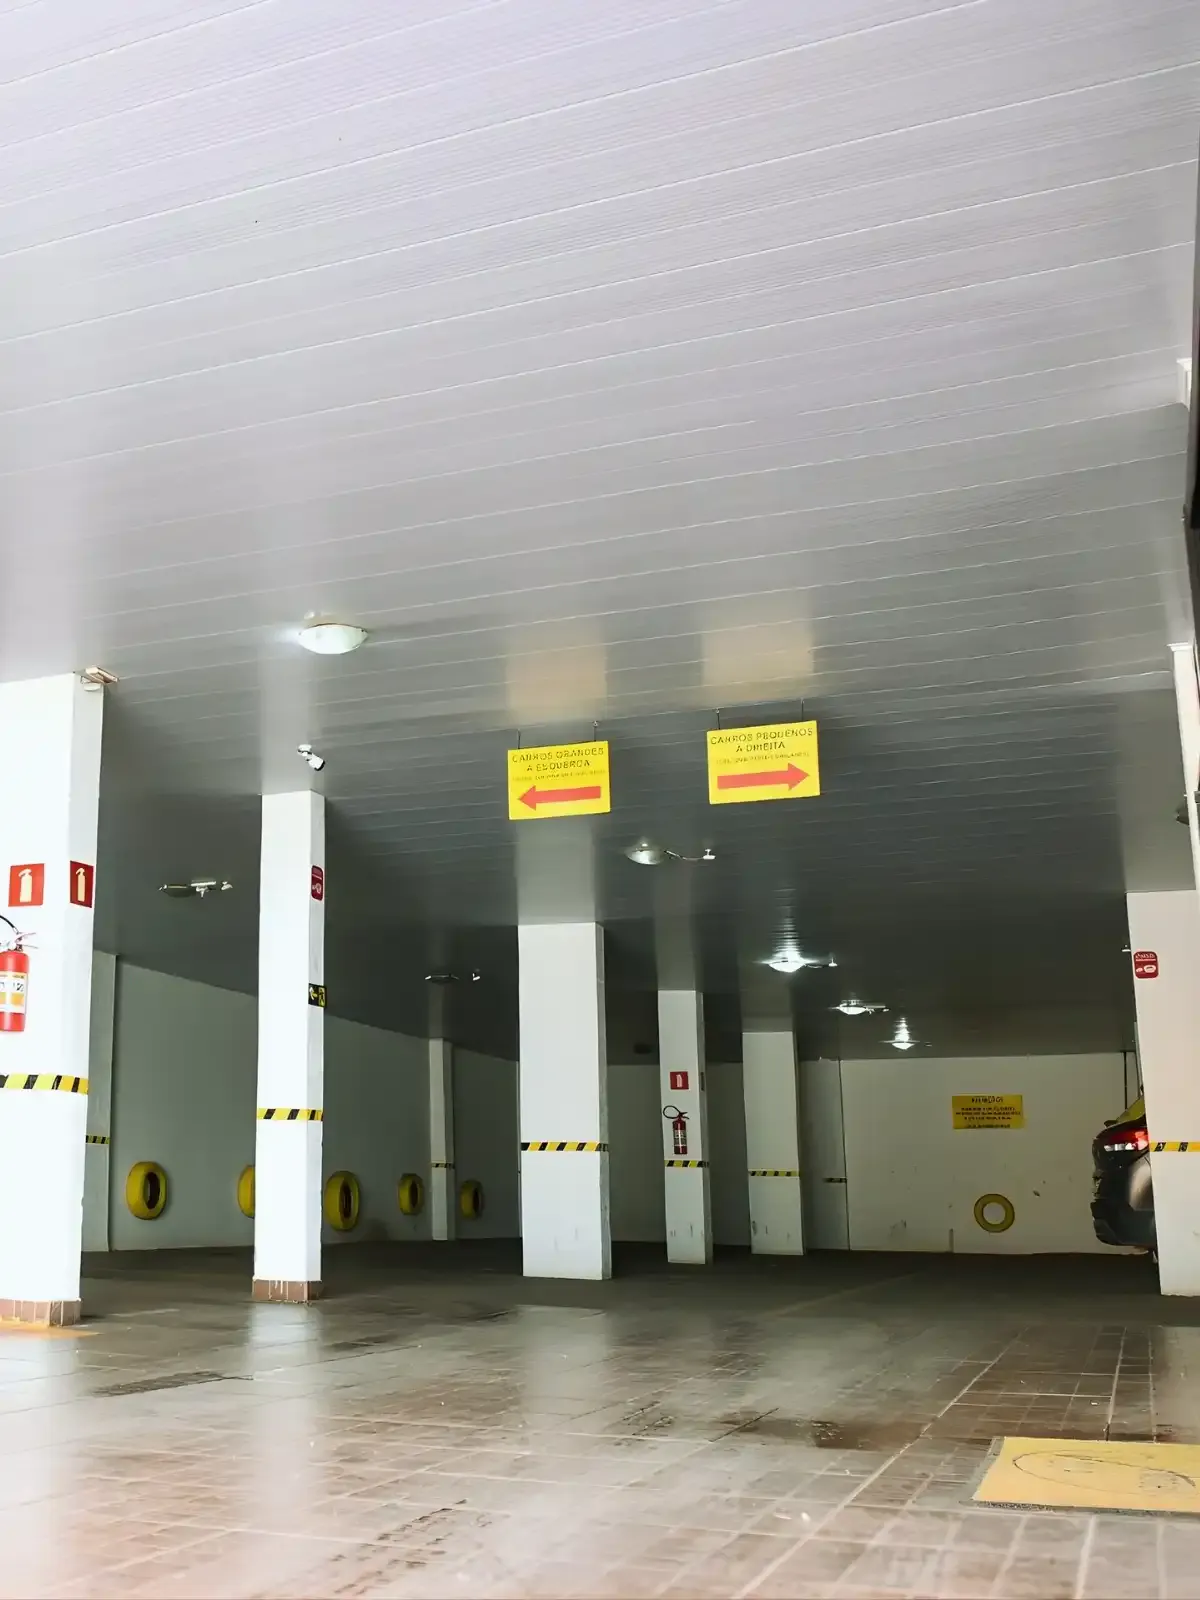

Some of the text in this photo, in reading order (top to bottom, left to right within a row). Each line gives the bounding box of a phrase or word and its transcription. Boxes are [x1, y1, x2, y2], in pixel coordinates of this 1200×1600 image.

[710, 727, 813, 745] CARROS PEQUENOS
[746, 741, 786, 752] DIREITA
